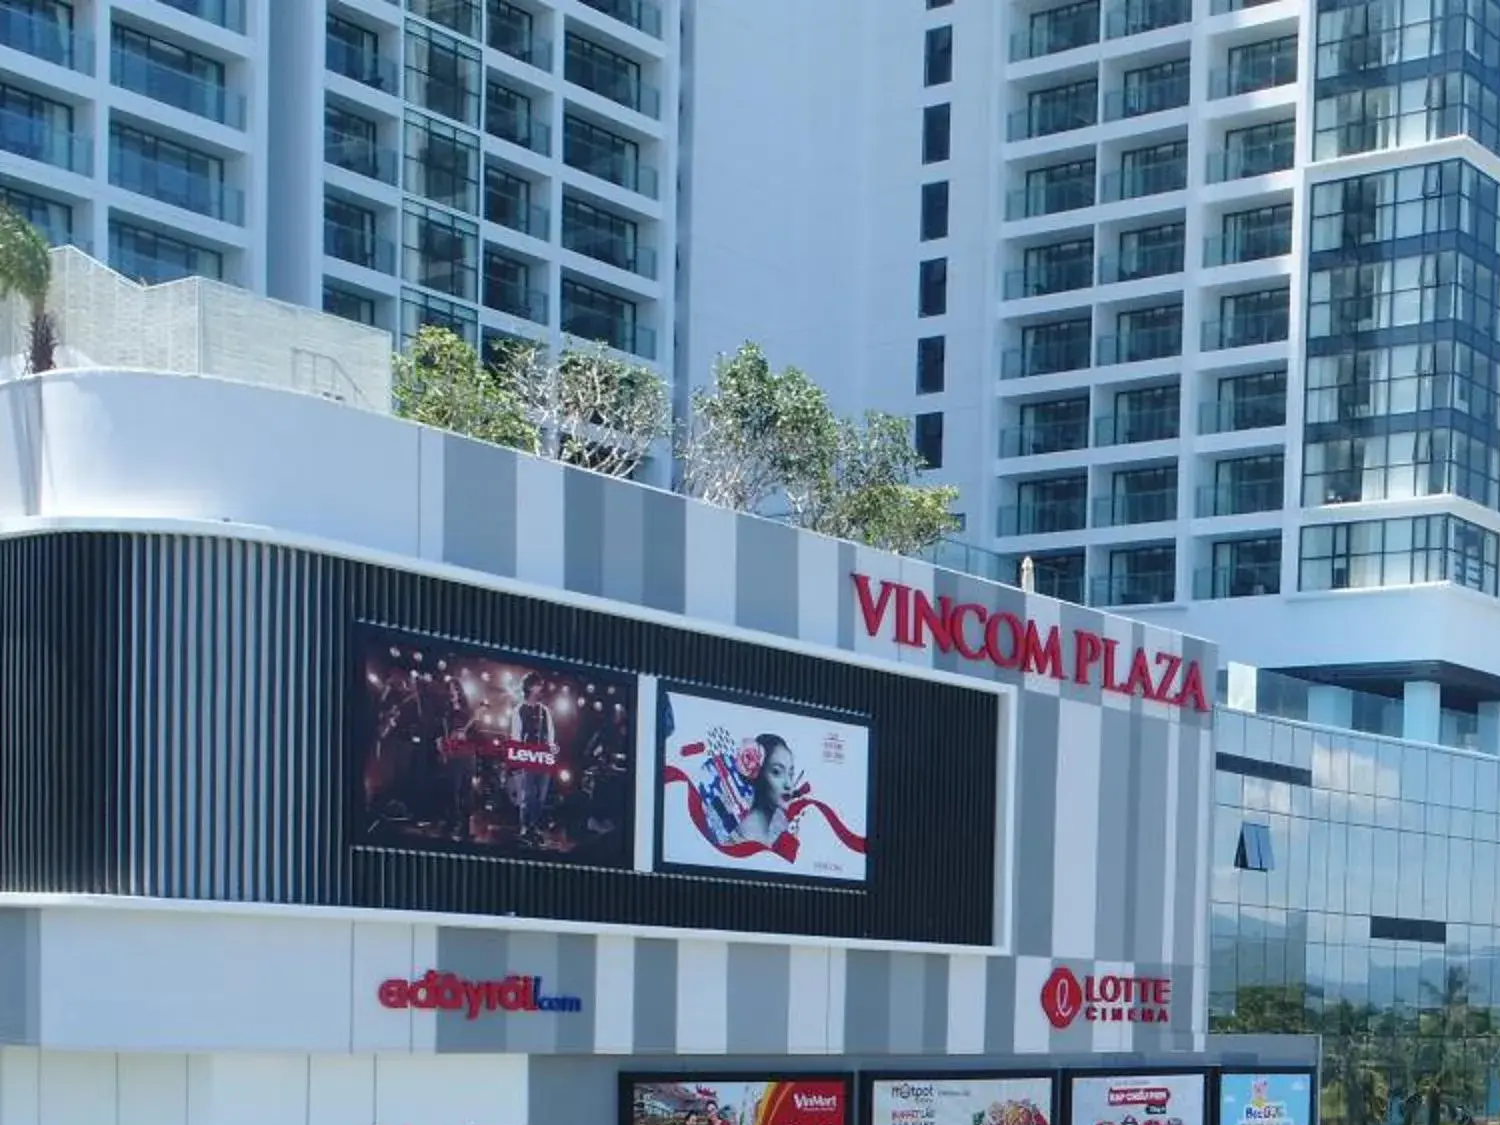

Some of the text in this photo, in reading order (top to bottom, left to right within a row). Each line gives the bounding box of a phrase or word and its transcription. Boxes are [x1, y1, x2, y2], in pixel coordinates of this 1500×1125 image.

[850, 572, 1212, 713] VINCOM PLAZA
[1084, 975, 1172, 1005] LOTTE
[1085, 1007, 1169, 1023] CINEMA
[793, 1092, 837, 1110] VinMart
